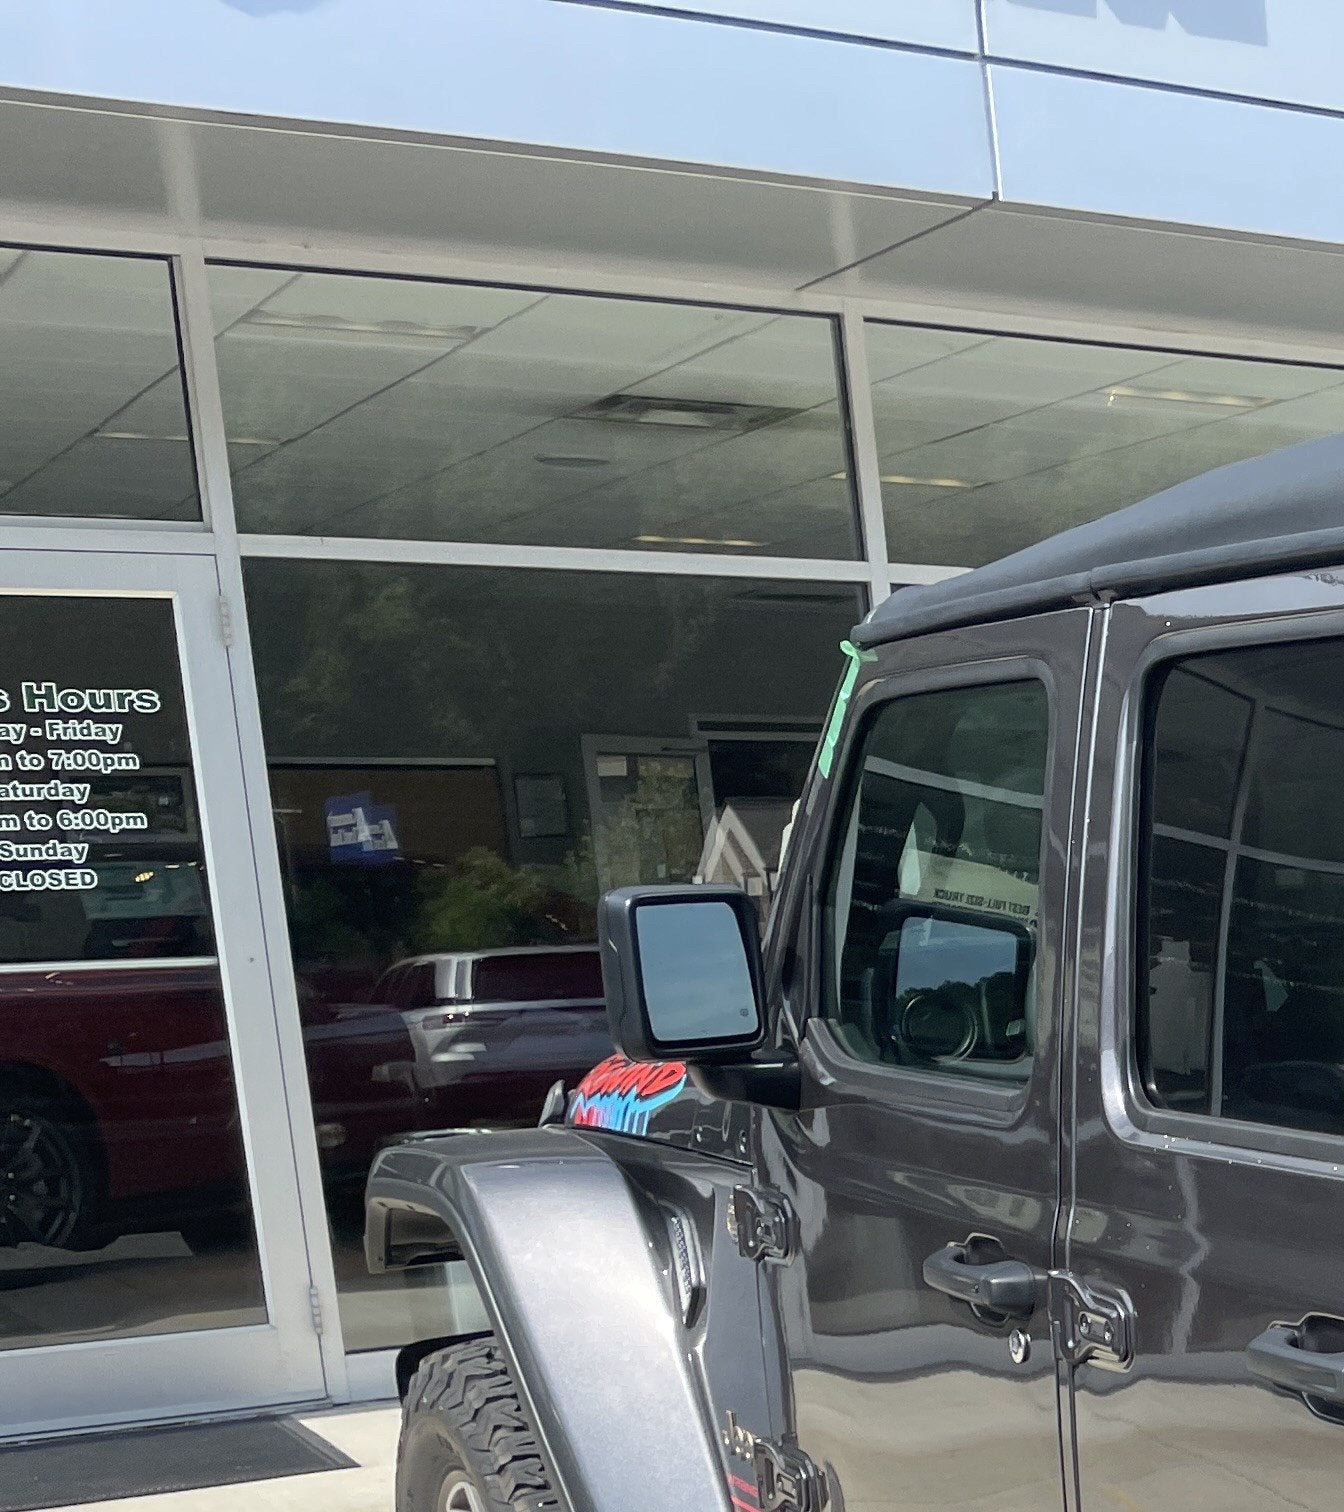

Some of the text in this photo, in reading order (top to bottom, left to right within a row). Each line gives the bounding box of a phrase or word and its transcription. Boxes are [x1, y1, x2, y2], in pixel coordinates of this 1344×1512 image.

[22, 682, 161, 713] Hours
[45, 719, 122, 744] Friday
[16, 750, 44, 771] to
[47, 749, 140, 774] 7:00pm
[24, 810, 53, 831] to
[56, 809, 148, 833] 6:00pm
[0, 840, 89, 864] Sunday
[0, 869, 98, 891] CLOSED
